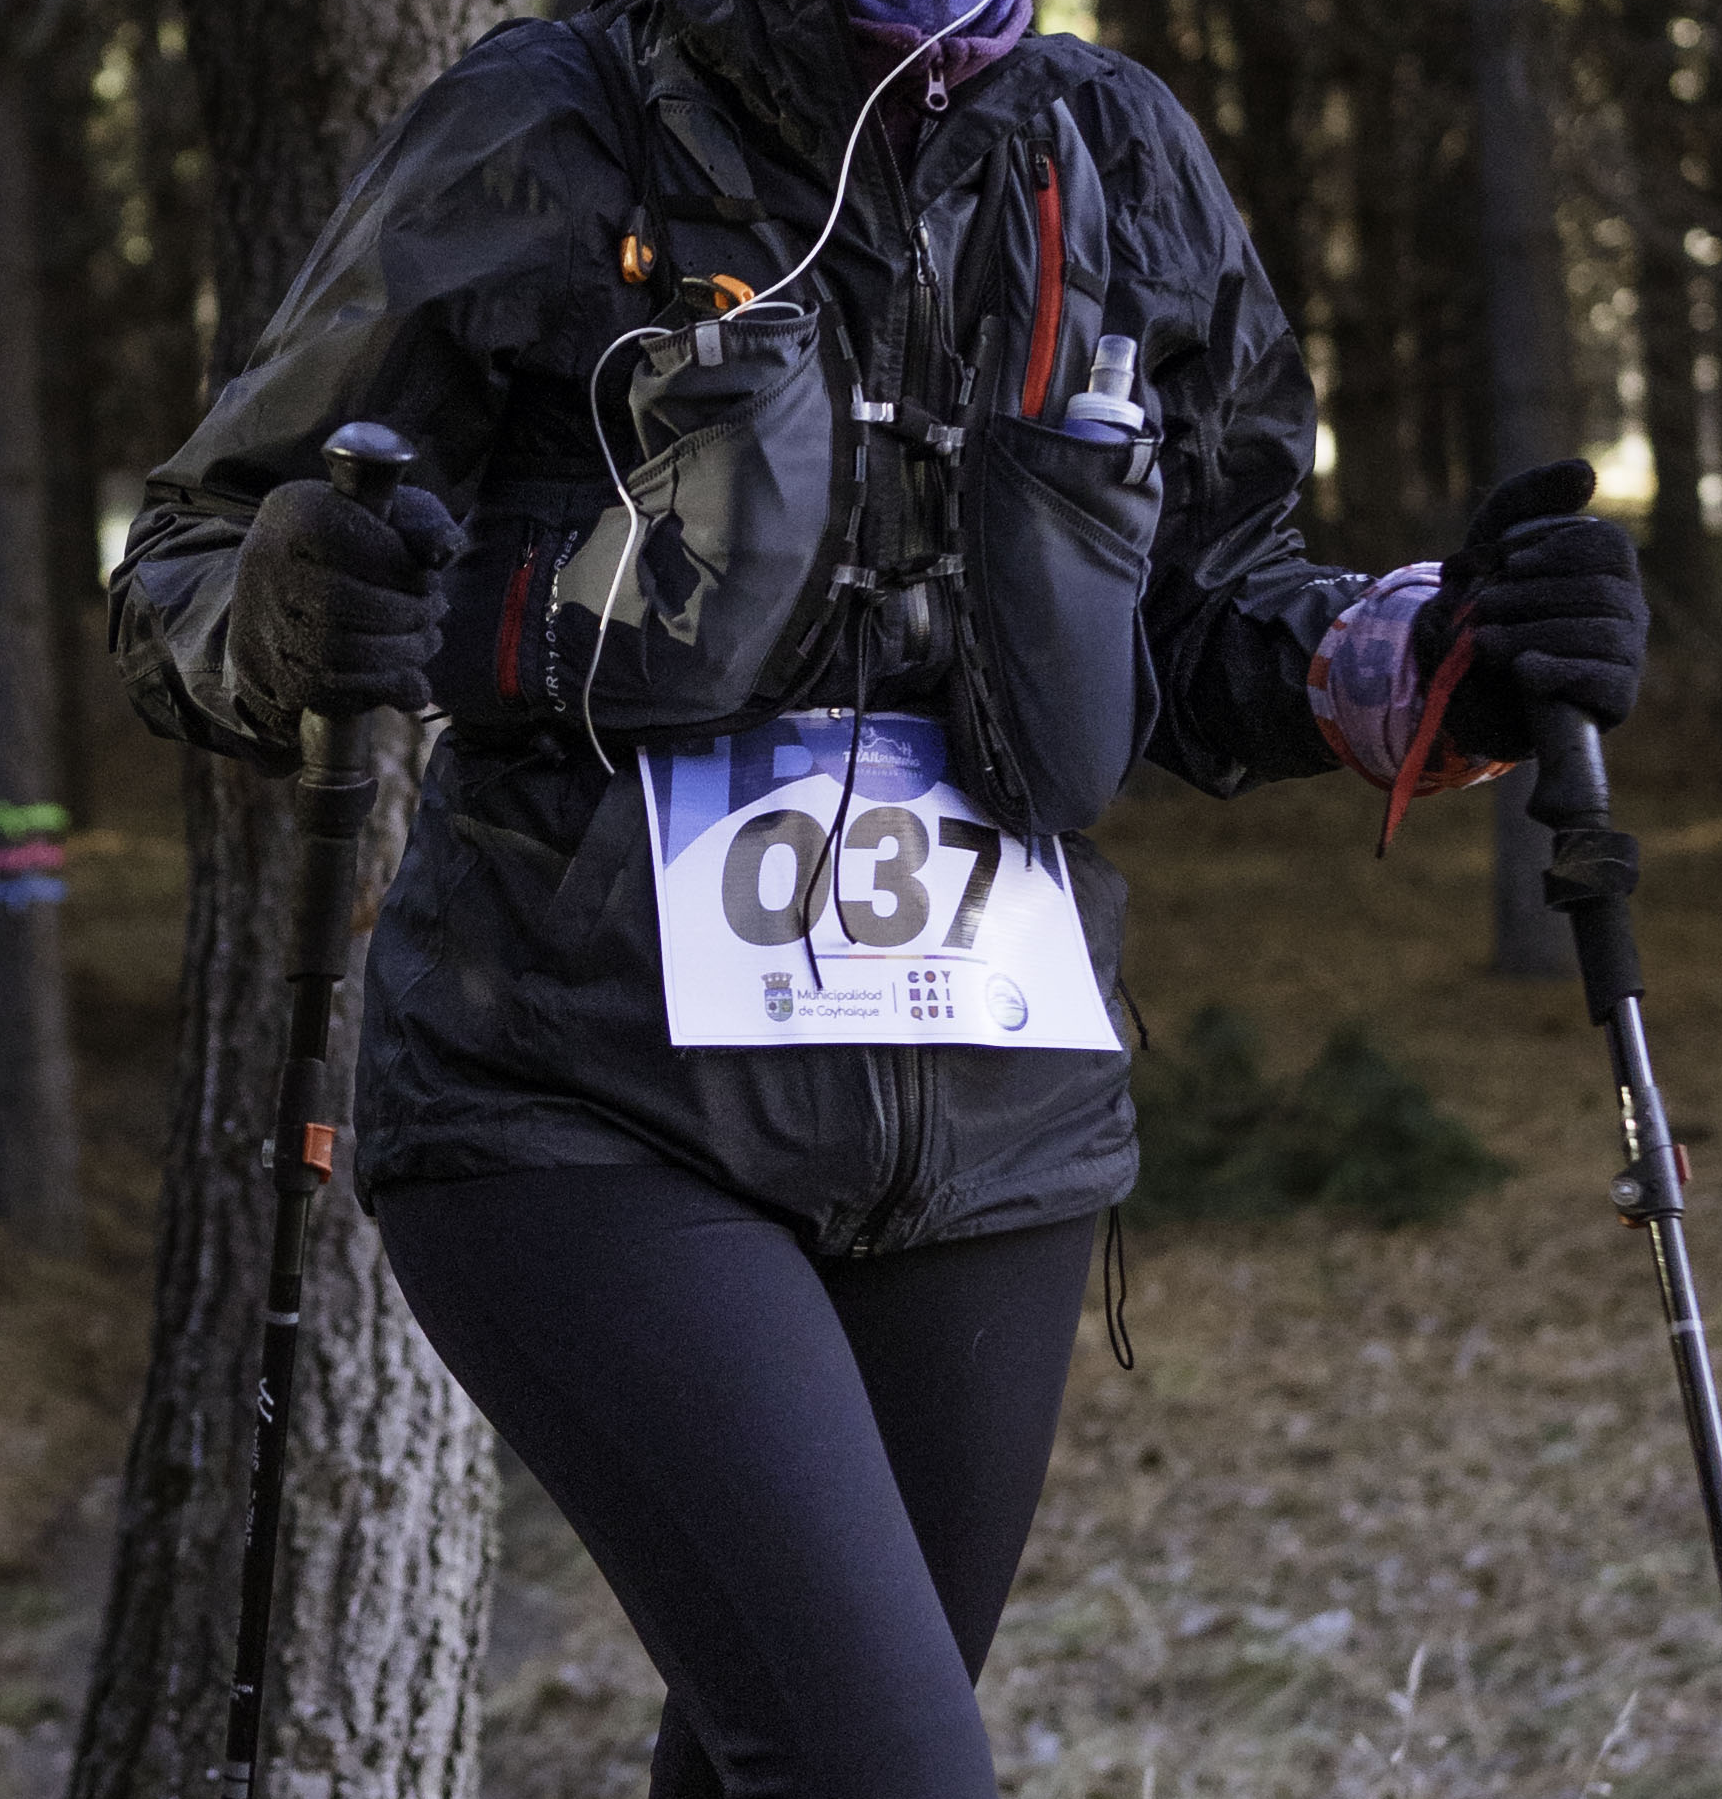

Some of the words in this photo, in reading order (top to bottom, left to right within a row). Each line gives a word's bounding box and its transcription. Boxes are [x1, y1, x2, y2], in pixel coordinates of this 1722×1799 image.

[721, 806, 1001, 950] 037
[797, 989, 883, 1003] Municipalidad
[798, 1005, 814, 1017] de
[816, 1005, 880, 1020] Coyhaique
